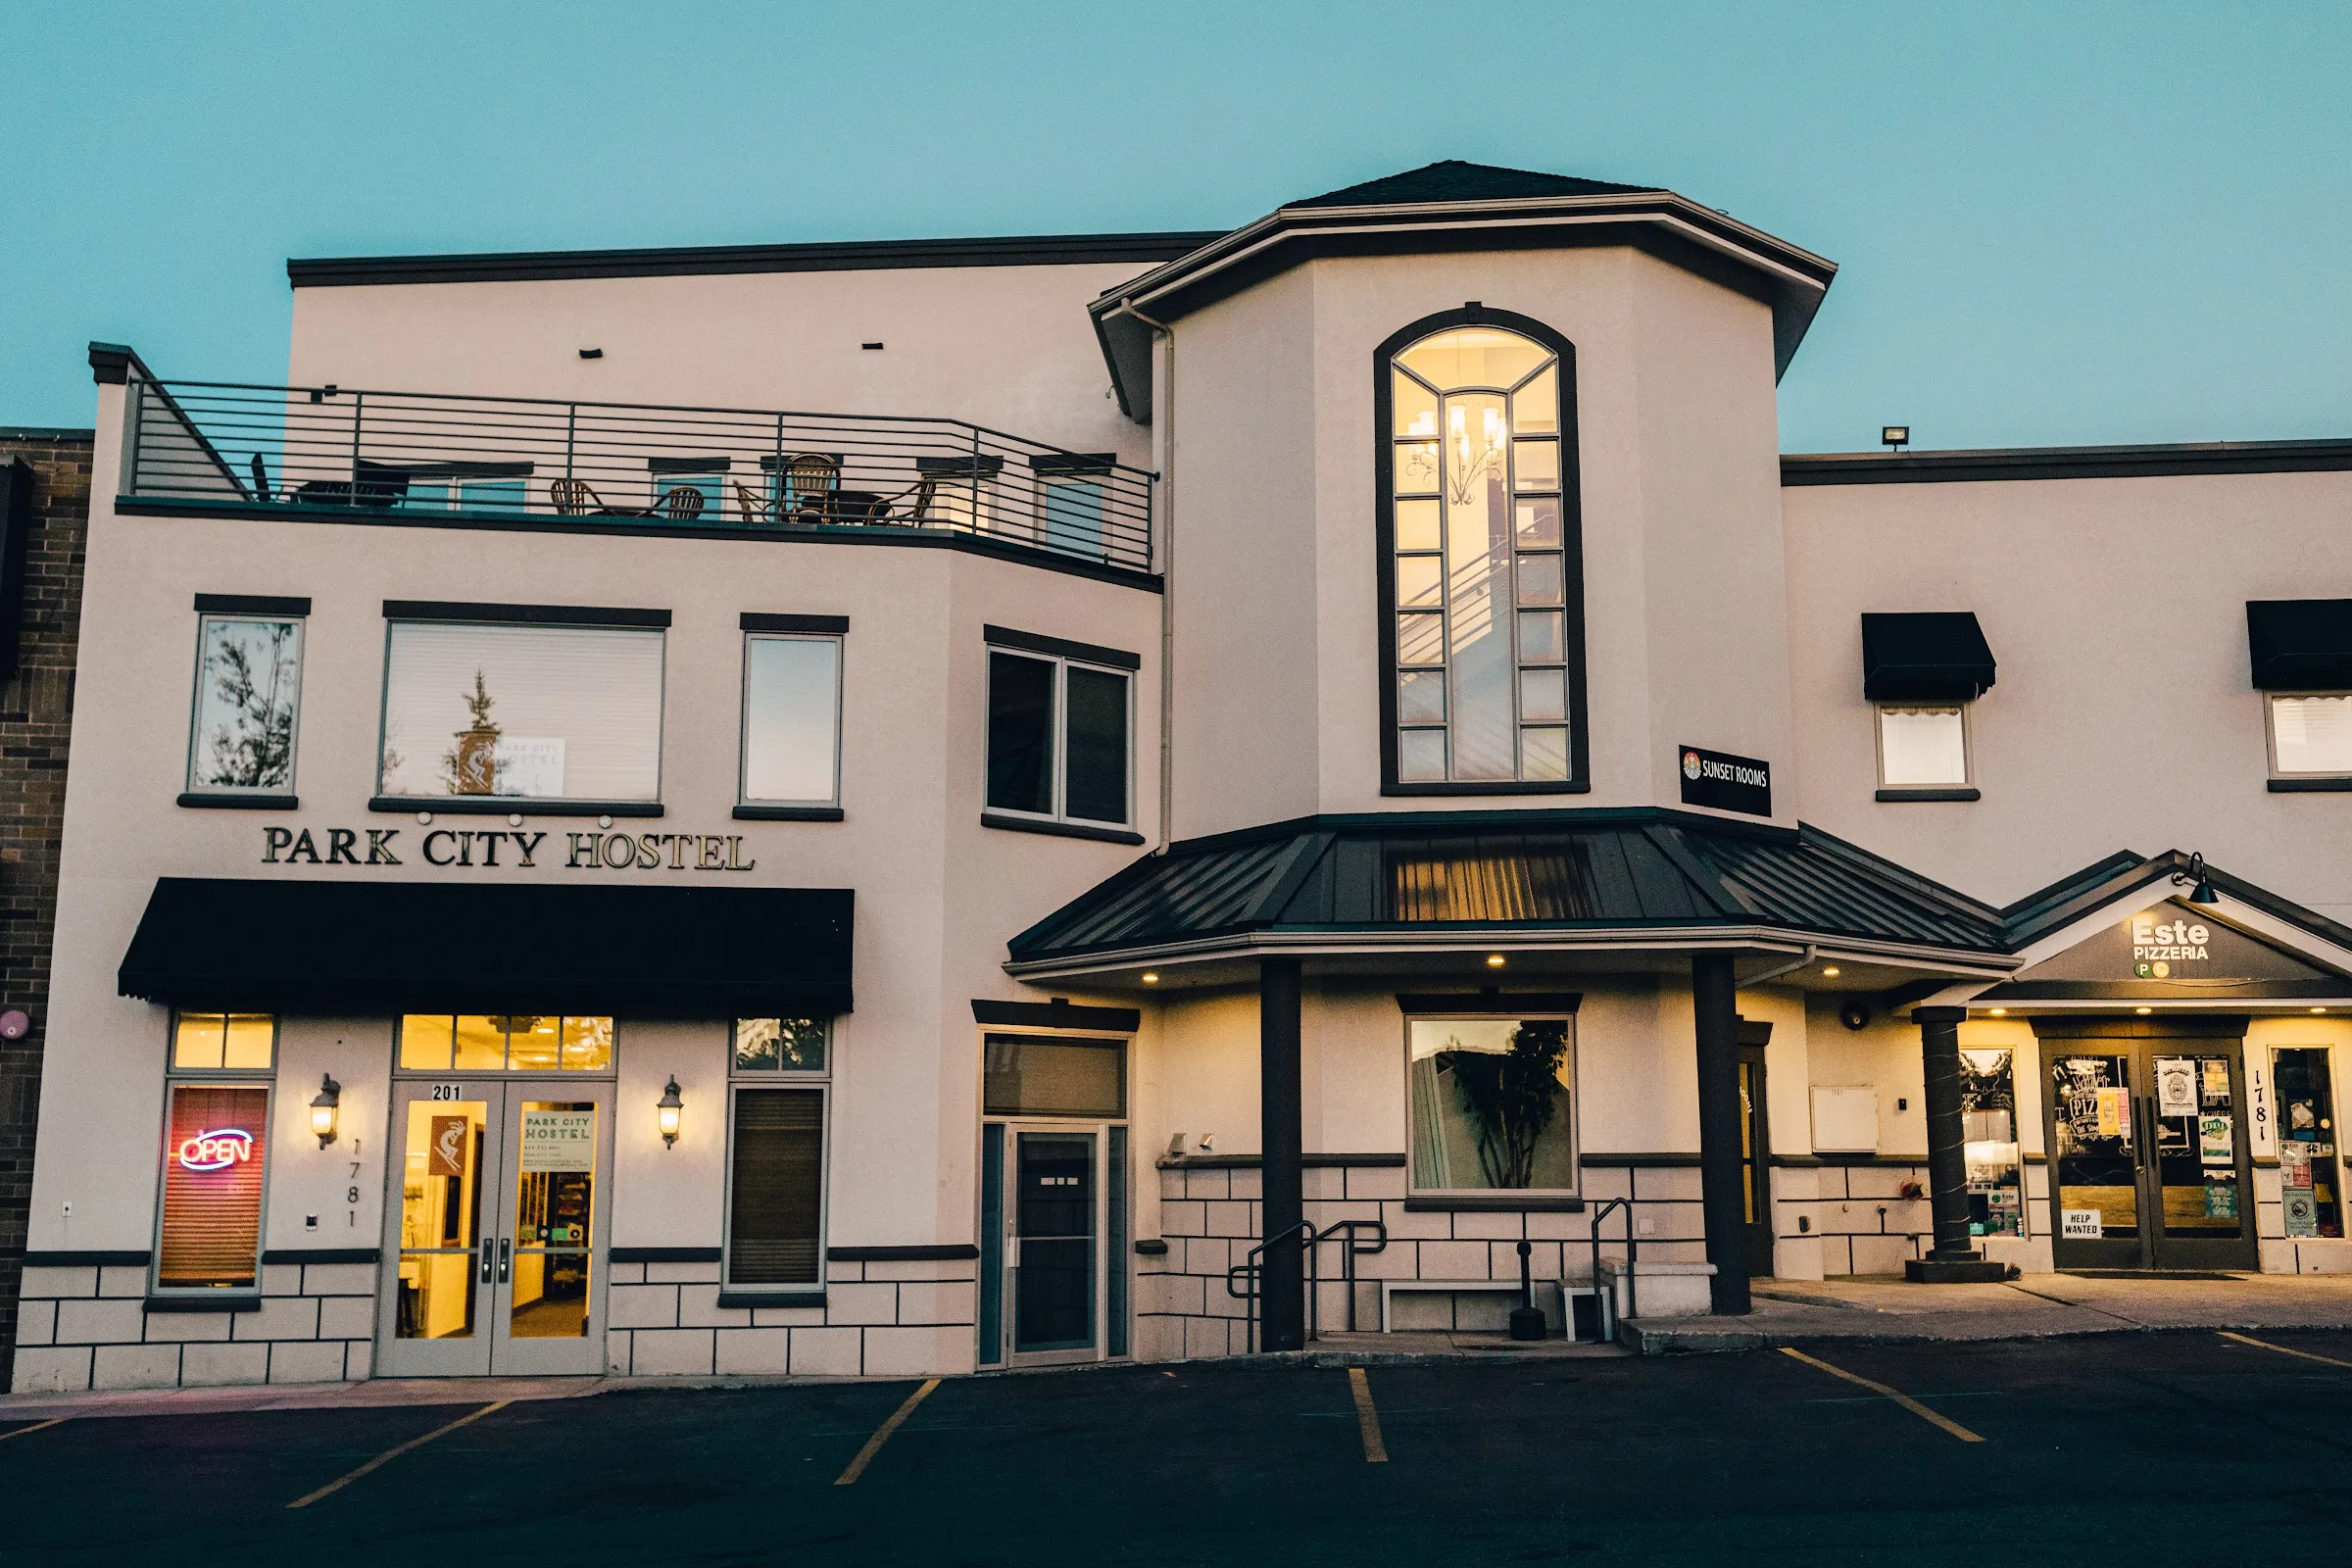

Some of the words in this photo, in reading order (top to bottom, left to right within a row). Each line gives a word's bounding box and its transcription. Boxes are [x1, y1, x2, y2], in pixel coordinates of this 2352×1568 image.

[1702, 760, 1735, 782] SUNSET
[1736, 766, 1767, 788] ROOMS
[262, 827, 403, 864] PARK
[422, 830, 547, 867] CITY
[564, 833, 756, 870] HOSTEL
[2132, 917, 2209, 946] Este
[2133, 946, 2209, 960] PIZZERIA
[433, 1085, 460, 1101] 201
[2074, 1099, 2098, 1115] PIZ
[2255, 1070, 2267, 1141] 1781
[525, 1129, 590, 1139] HOSTEL
[179, 1138, 250, 1162] OPEN
[348, 1139, 361, 1227] 1781
[2071, 1214, 2091, 1223] HELP
[2065, 1225, 2097, 1234] WANTED
